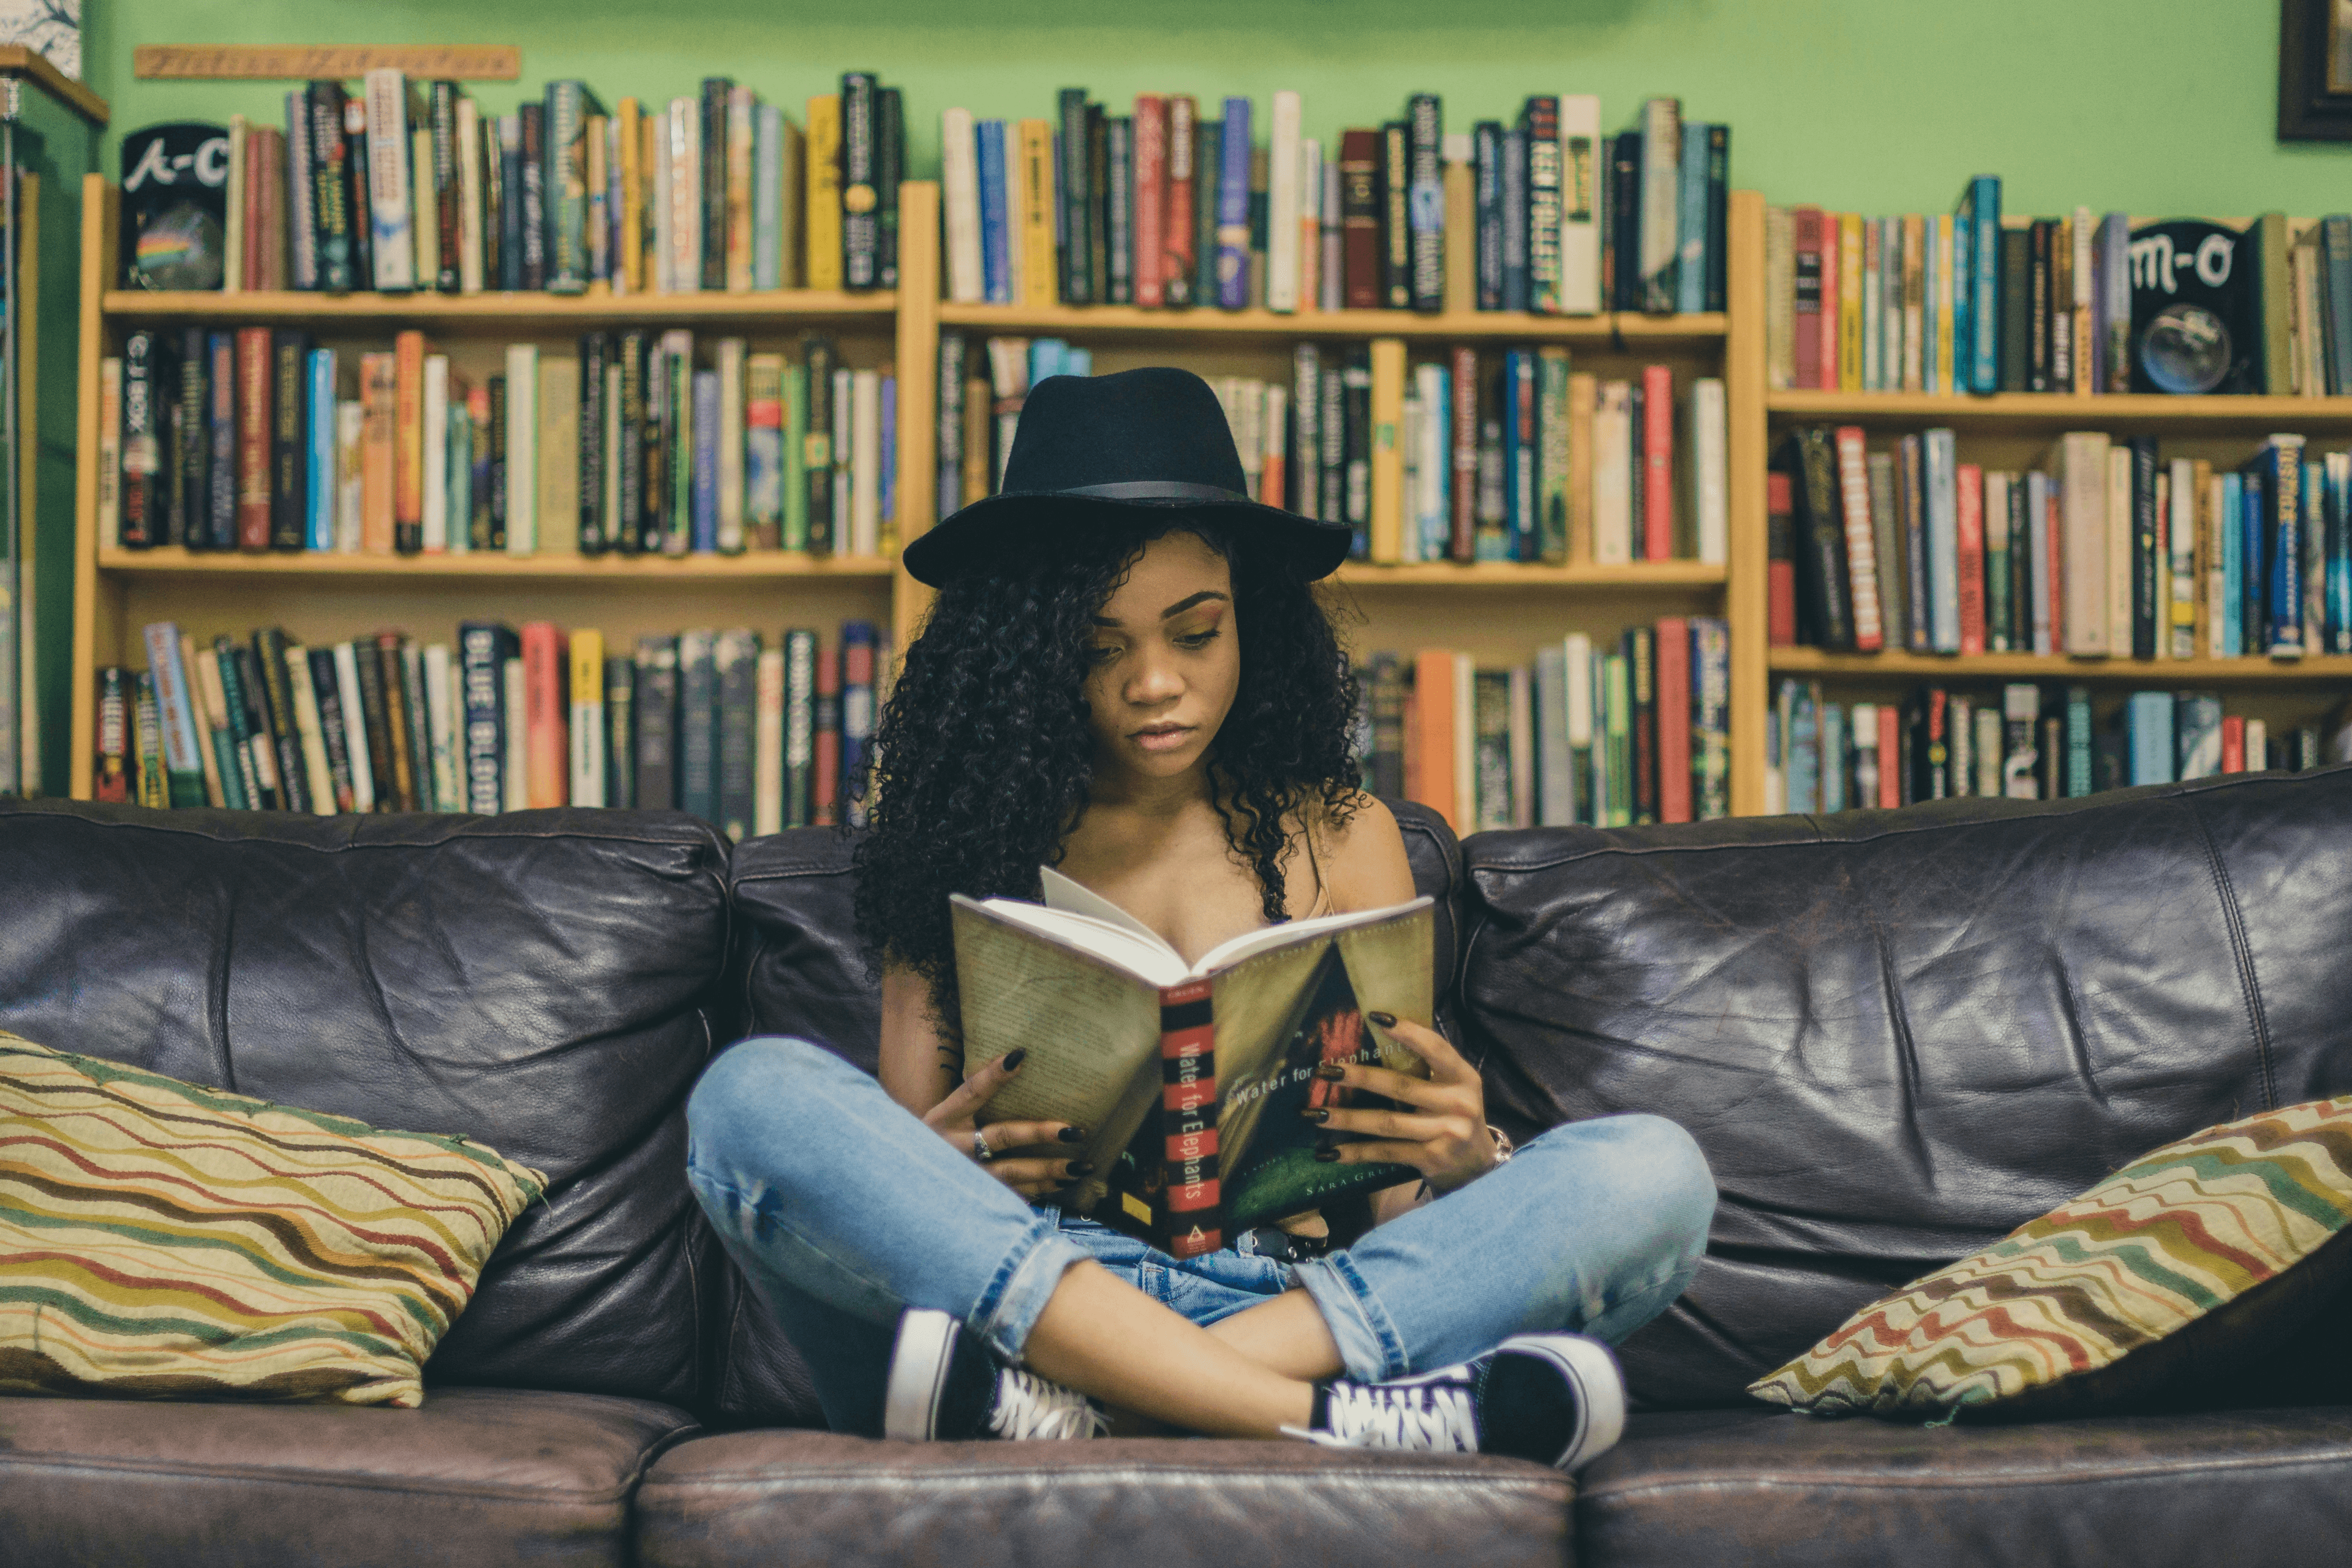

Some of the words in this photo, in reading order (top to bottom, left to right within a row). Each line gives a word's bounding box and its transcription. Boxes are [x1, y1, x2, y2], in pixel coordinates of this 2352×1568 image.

[466, 630, 496, 709] BLUE
[1178, 1042, 1200, 1089] Water
[1236, 1074, 1286, 1106] Water
[1292, 1065, 1313, 1082] for
[1182, 1094, 1202, 1116] for
[1179, 1120, 1205, 1199] Elephants
[1306, 1178, 1347, 1196] SARA
